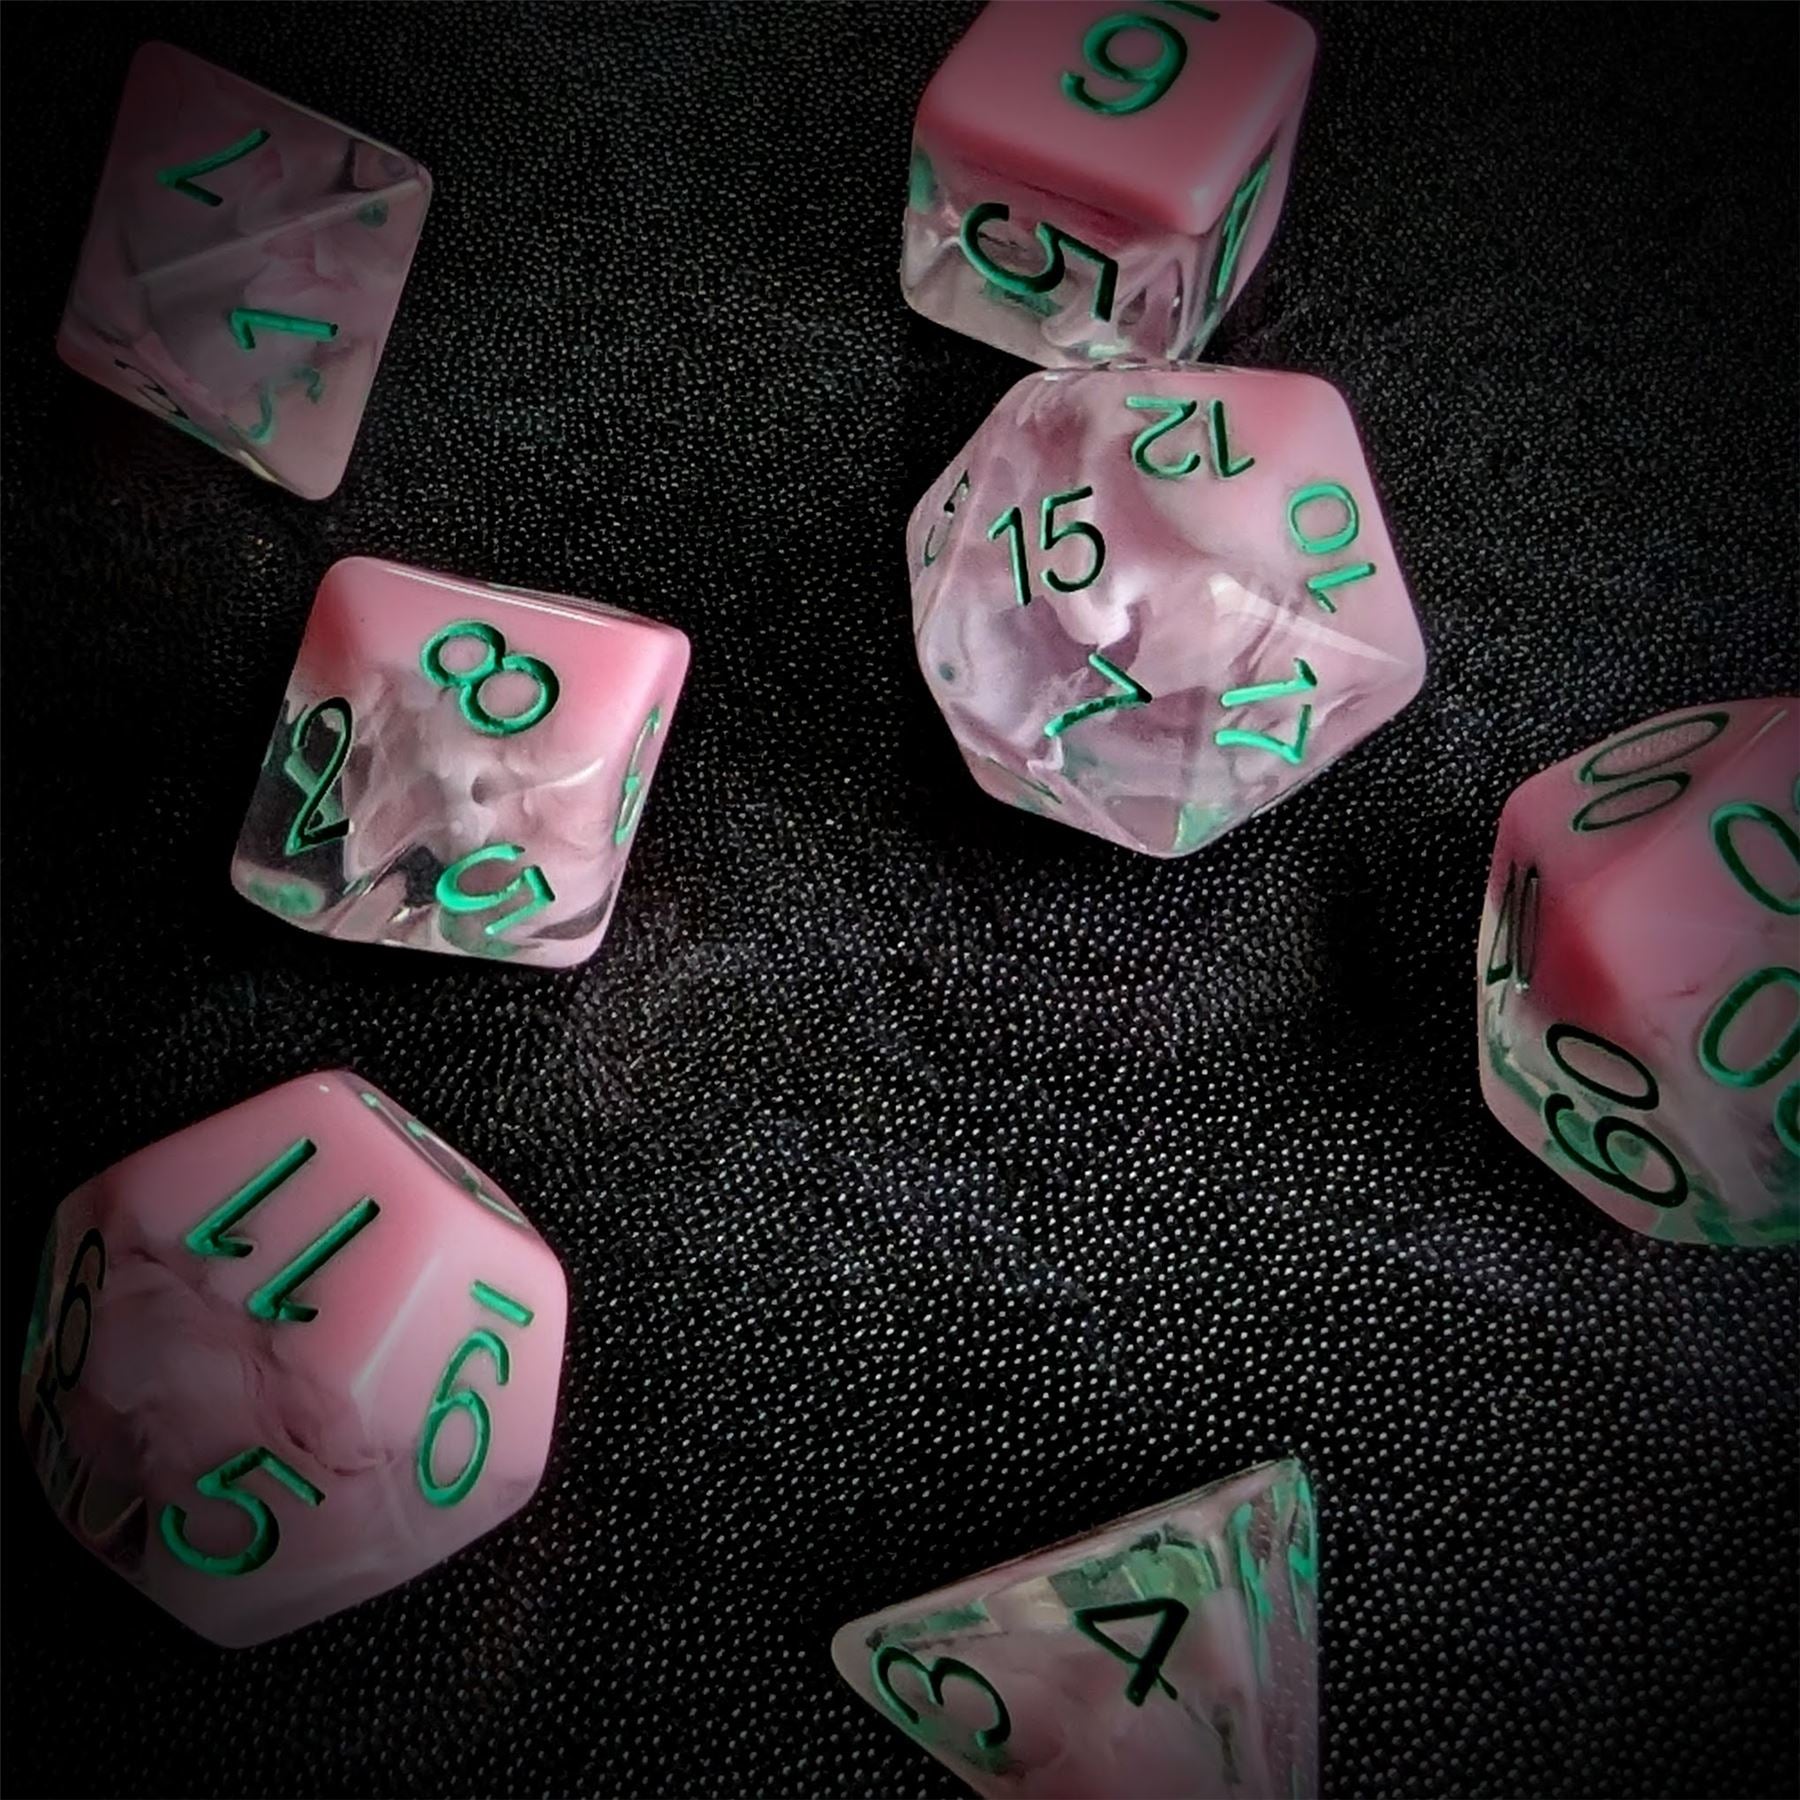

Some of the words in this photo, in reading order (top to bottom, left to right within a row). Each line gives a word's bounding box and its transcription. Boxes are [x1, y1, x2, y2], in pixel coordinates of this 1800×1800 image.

[960, 203, 1118, 321] 5
[229, 308, 338, 349] 1
[1125, 395, 1255, 479] 12
[986, 485, 1106, 606] 15
[1289, 481, 1376, 614] 10
[421, 620, 560, 737] 8
[1044, 652, 1152, 738] 7
[1214, 657, 1318, 764] 17
[283, 696, 351, 857] 2
[435, 844, 555, 936] 5
[1545, 1022, 1690, 1208] 60
[185, 1138, 381, 1323] 11
[159, 1446, 325, 1575] 5
[871, 1645, 1012, 1750] 3
[1075, 1599, 1189, 1705] 4
